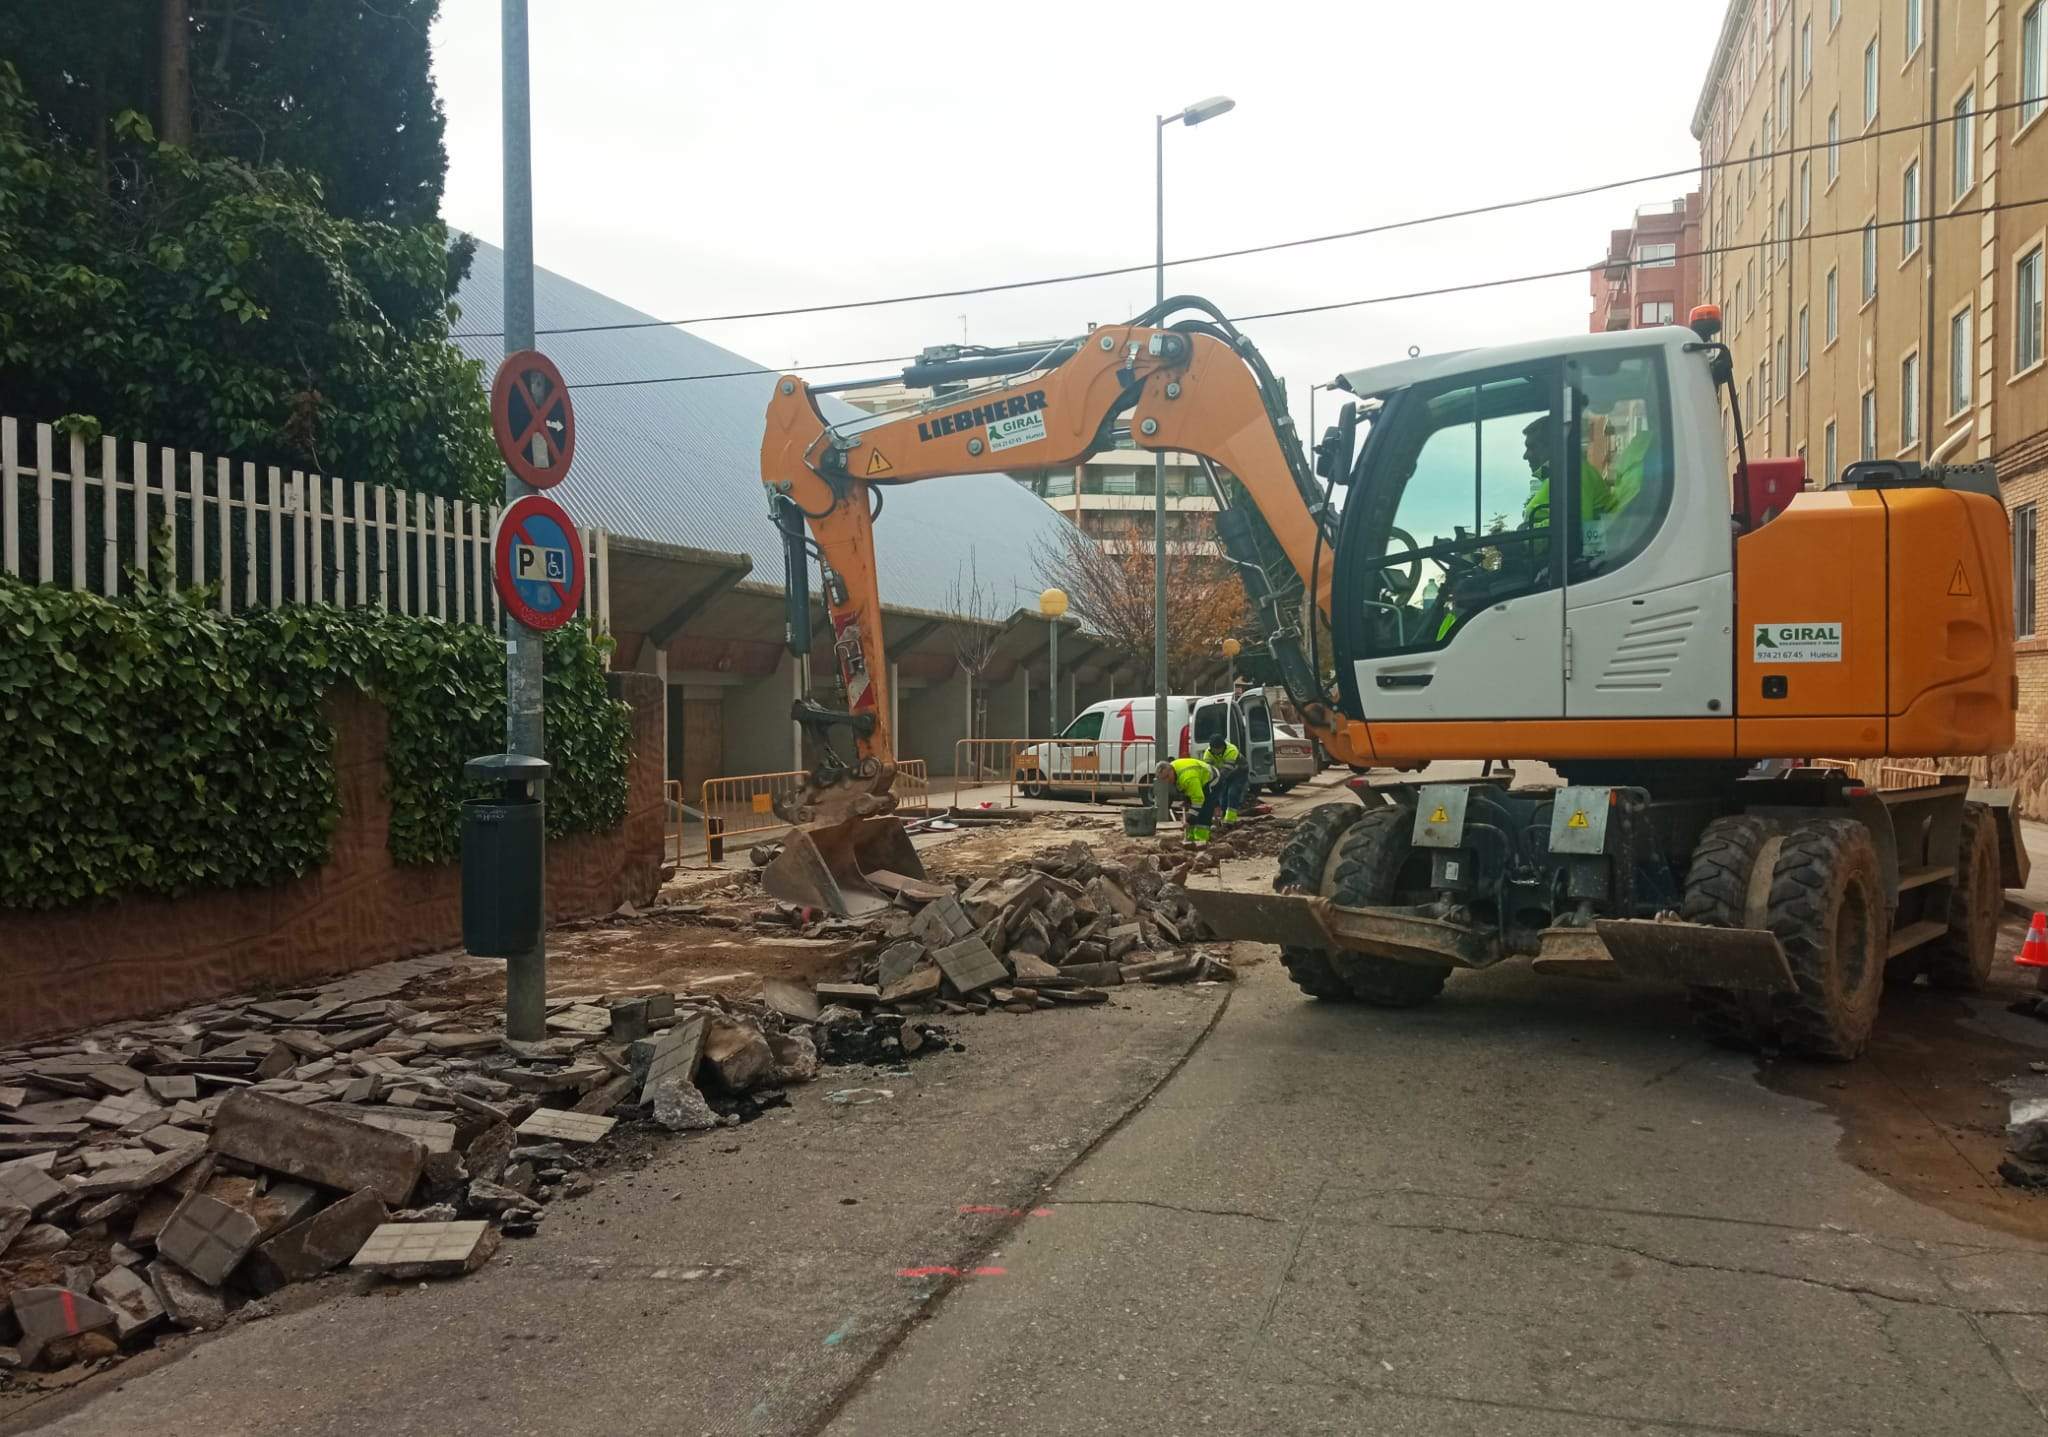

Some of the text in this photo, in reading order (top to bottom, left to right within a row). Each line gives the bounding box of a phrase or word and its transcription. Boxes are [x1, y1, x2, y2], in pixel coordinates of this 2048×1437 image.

[918, 389, 1048, 442] LIEBHERR
[1003, 415, 1042, 432] GIRAL
[519, 548, 534, 576] P
[1779, 628, 1840, 640] GIRAL
